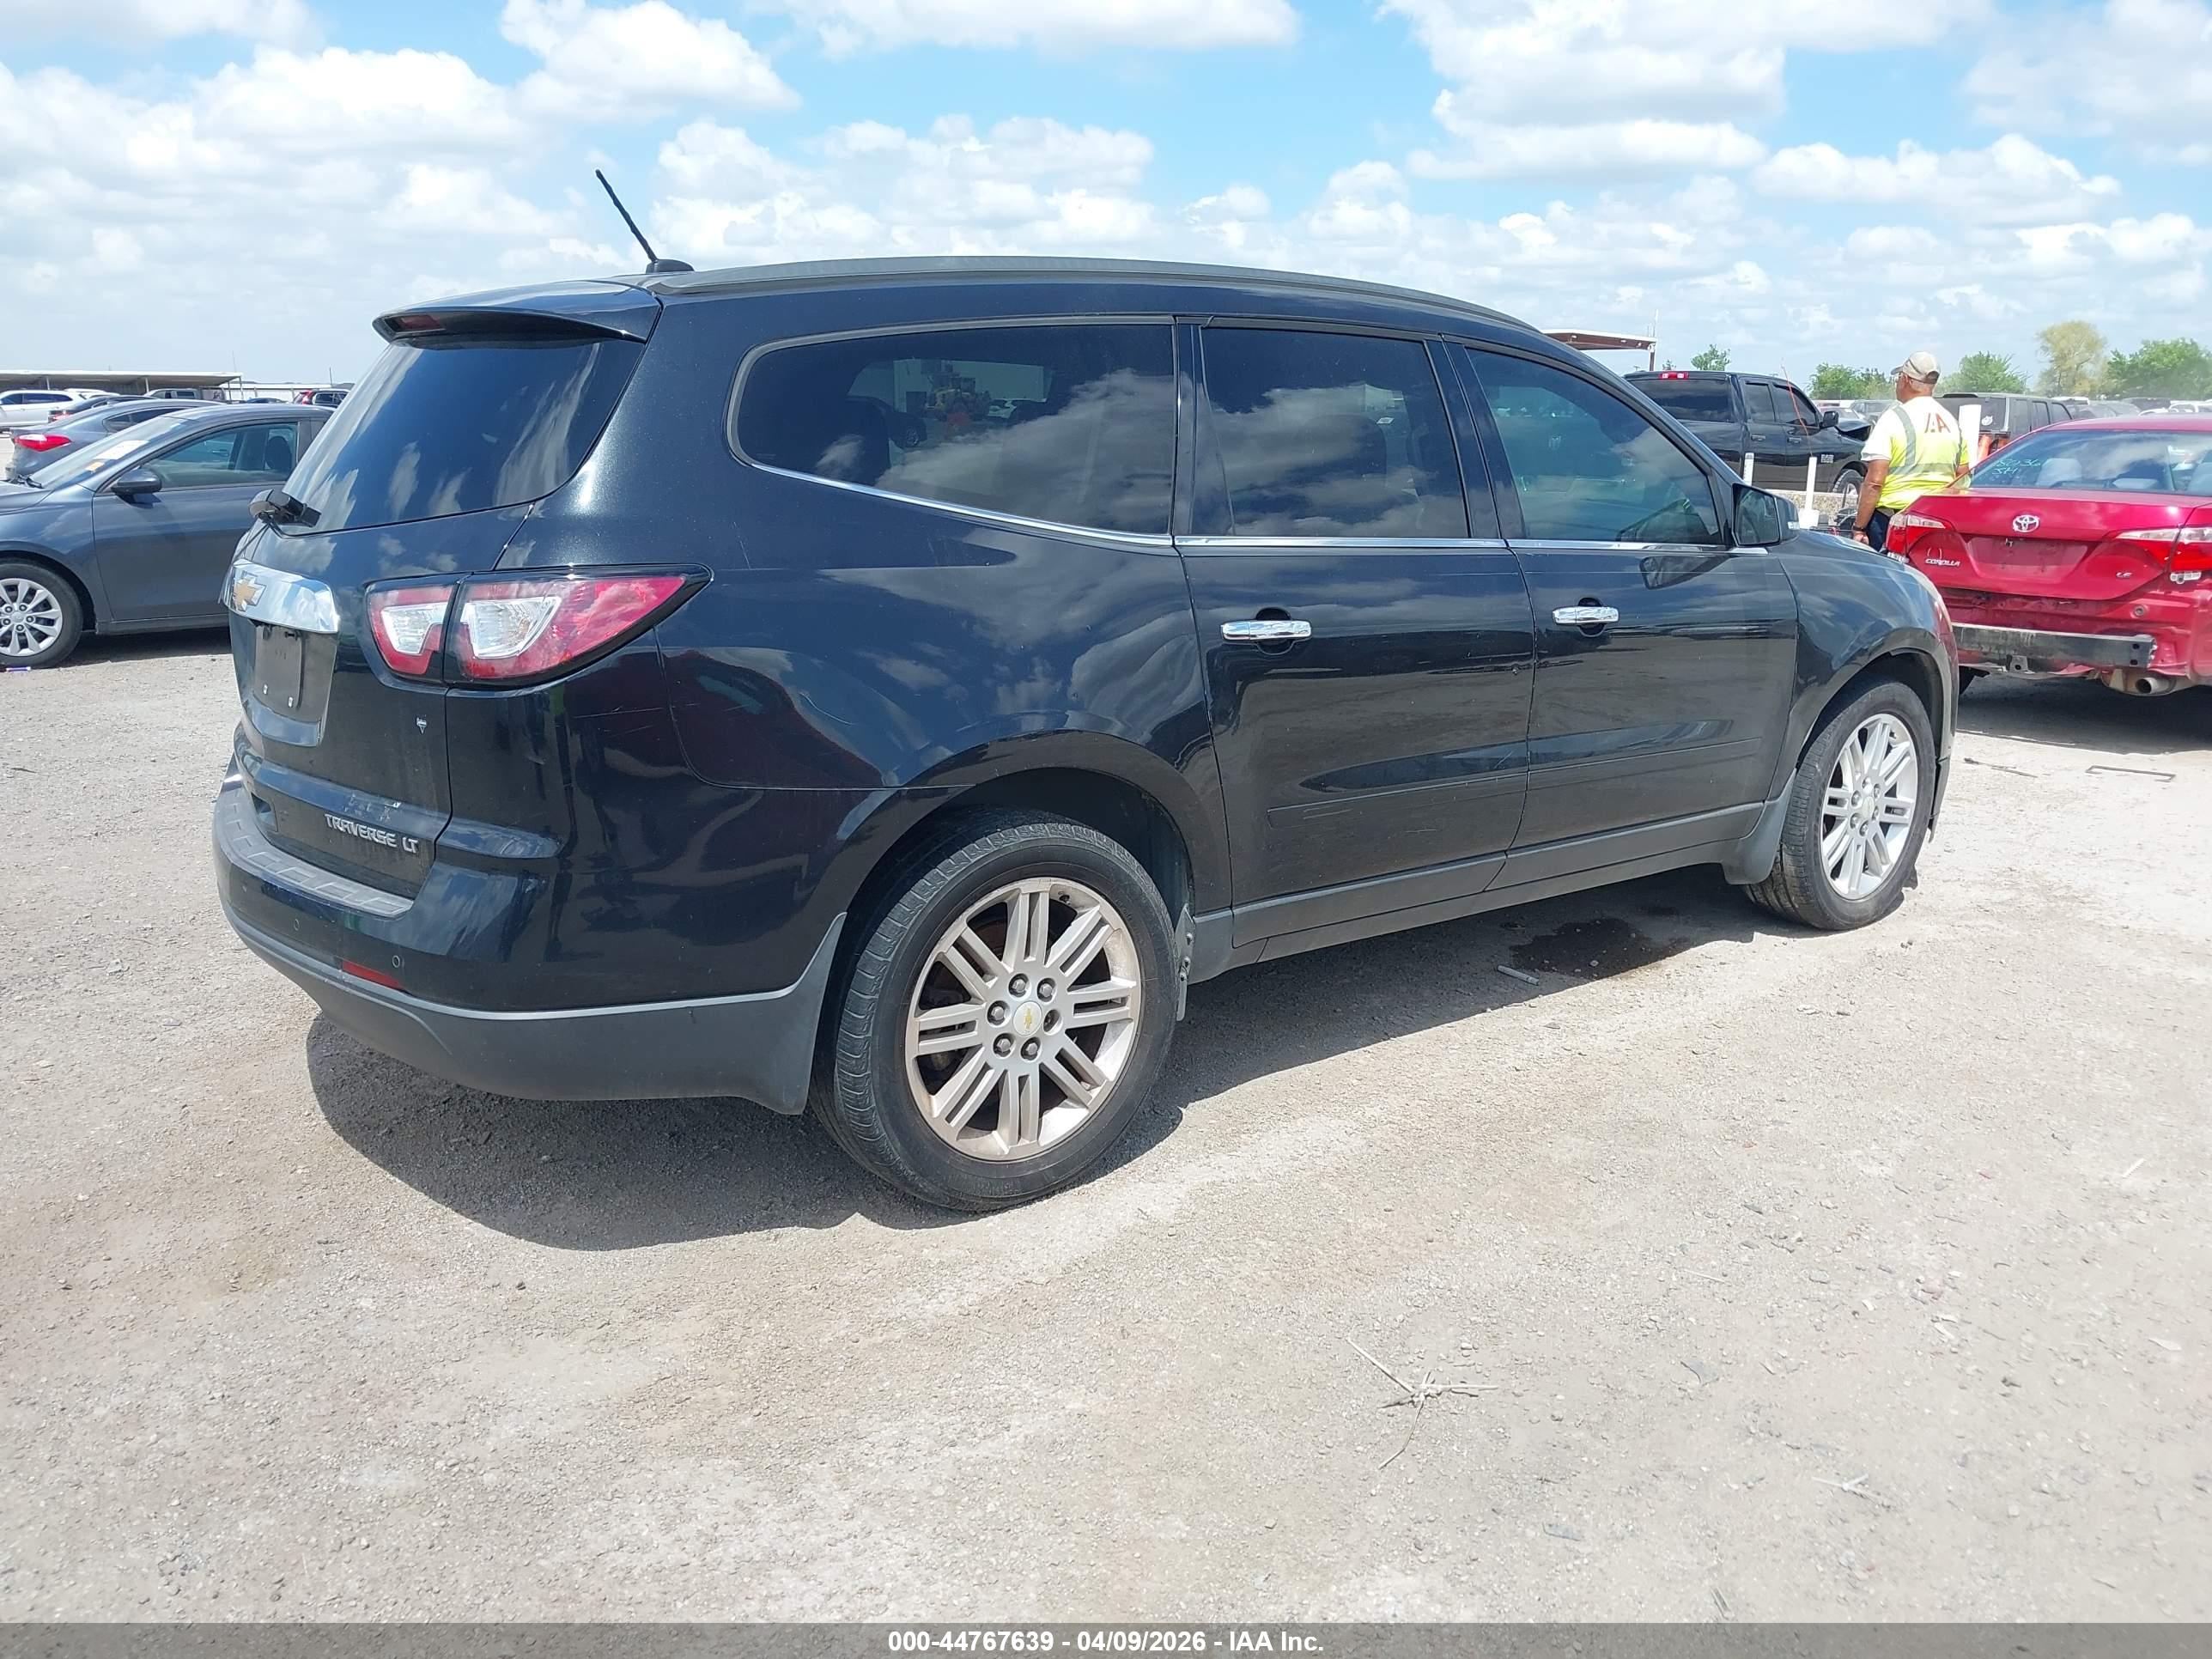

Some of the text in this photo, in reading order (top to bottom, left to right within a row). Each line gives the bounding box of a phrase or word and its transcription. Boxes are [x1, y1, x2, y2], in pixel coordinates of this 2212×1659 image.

[1925, 558, 1960, 567] COROLLA
[325, 813, 419, 854] TRAVERSE LT
